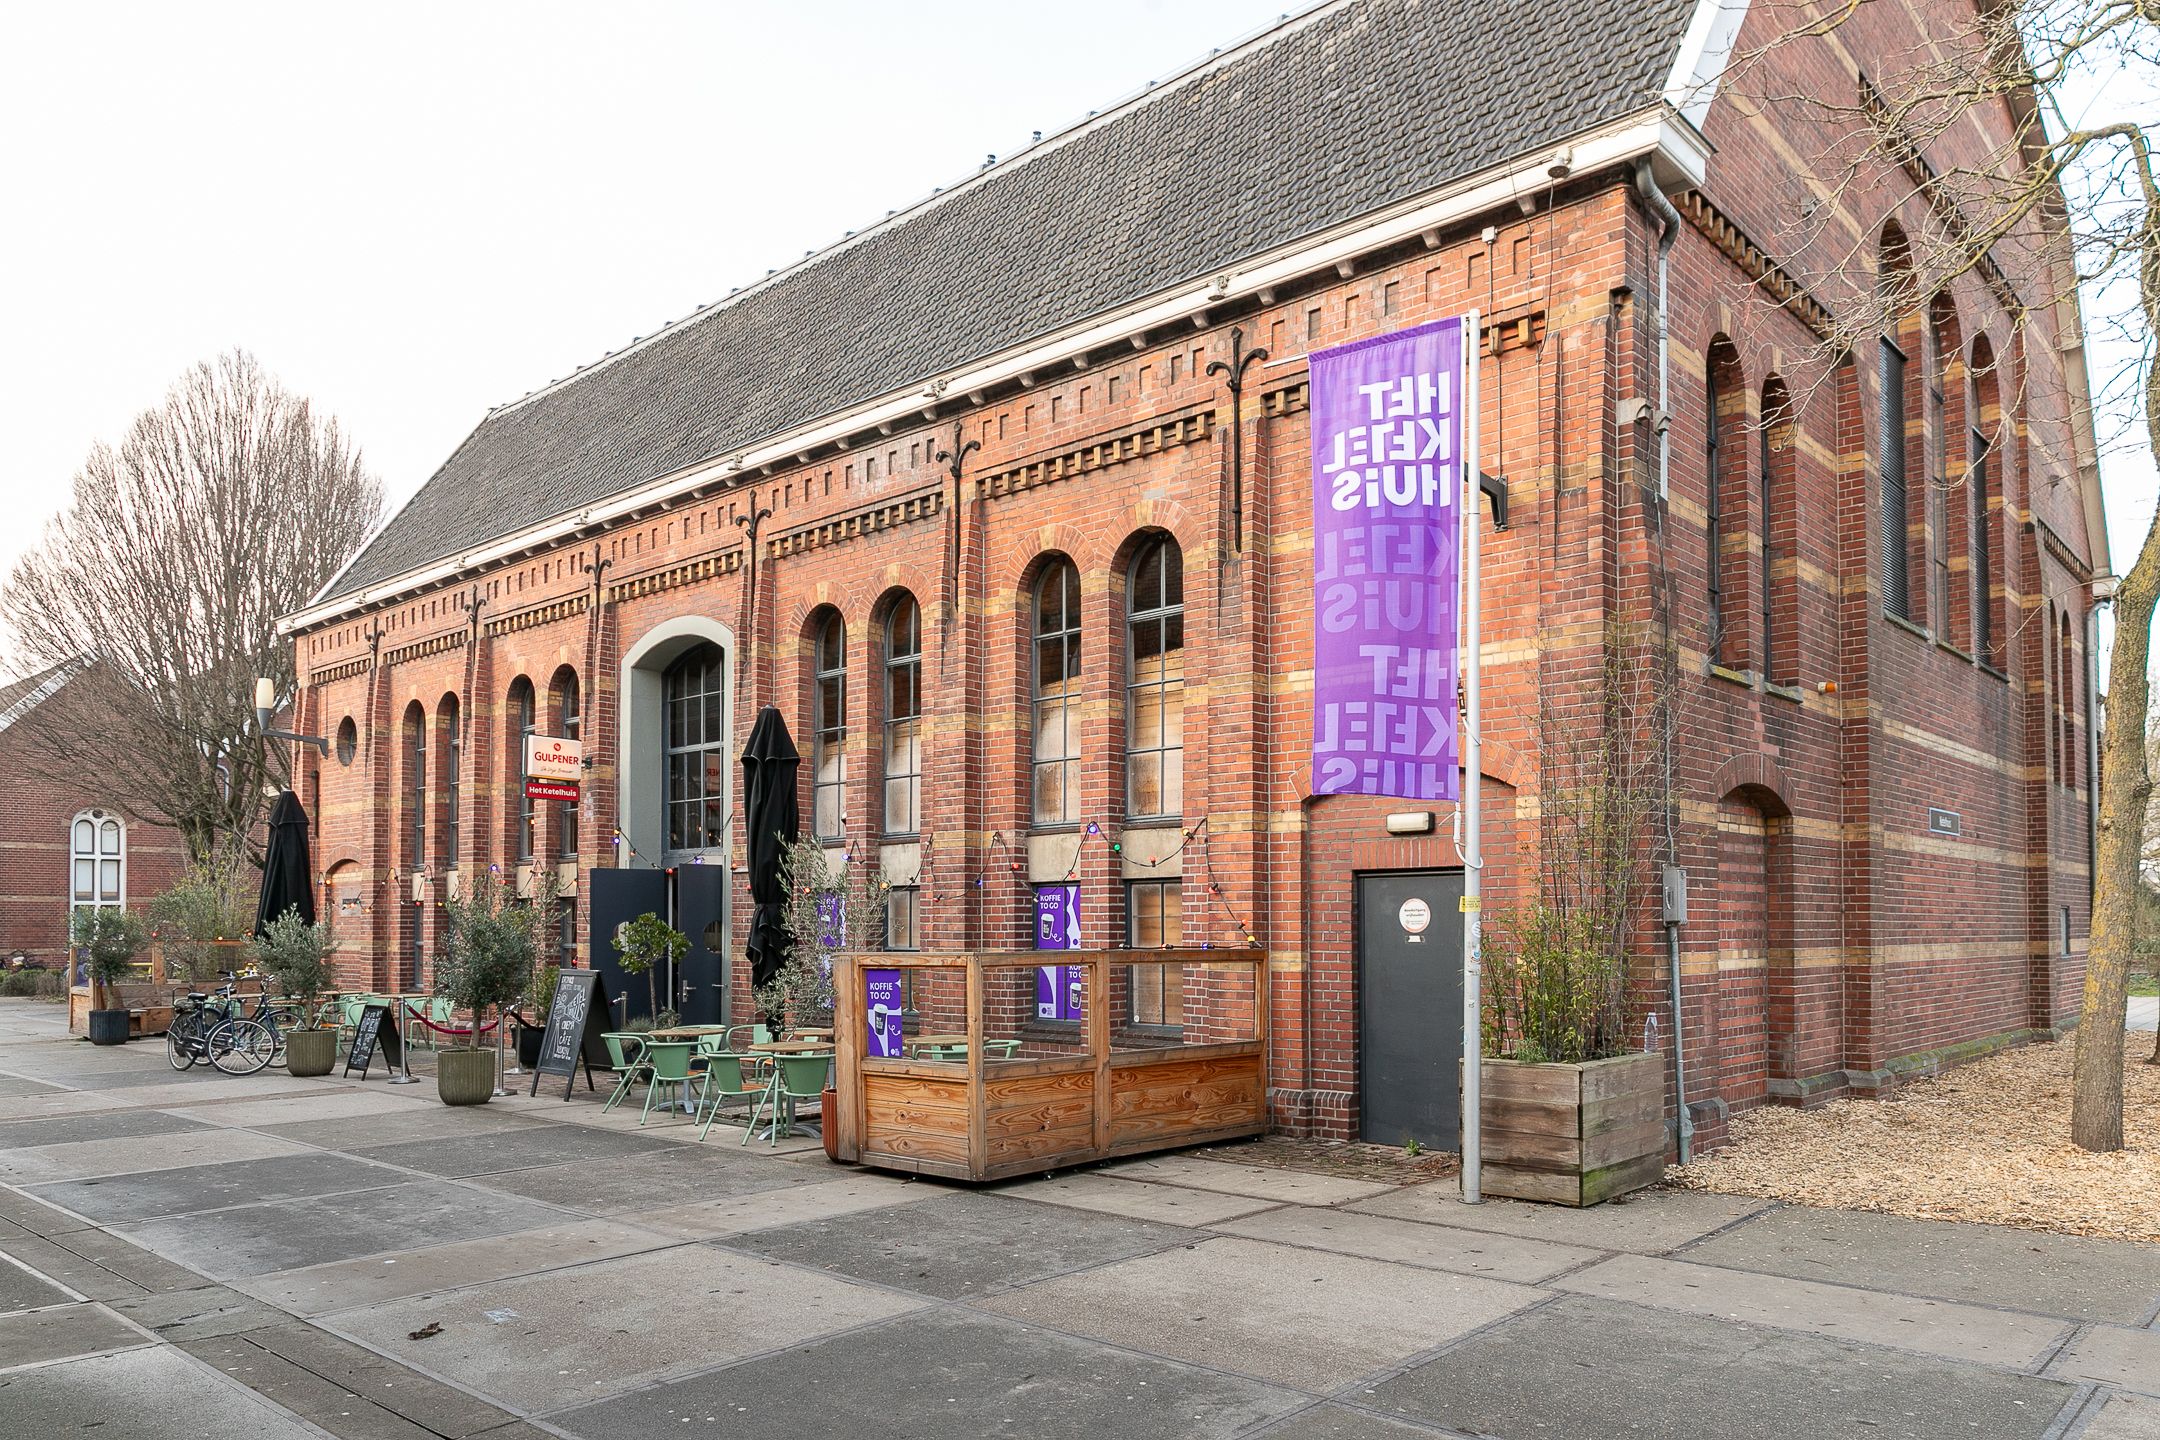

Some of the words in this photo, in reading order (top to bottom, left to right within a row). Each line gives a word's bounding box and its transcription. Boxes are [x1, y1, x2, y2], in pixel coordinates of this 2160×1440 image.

[534, 751, 579, 766] GULPENER
[529, 786, 542, 794] Het
[543, 787, 577, 797] Ketelhuis
[1040, 894, 1061, 902] KOFFIE
[869, 982, 893, 991] KOFFIE
[870, 991, 879, 1000] TO
[880, 991, 891, 1000] GO
